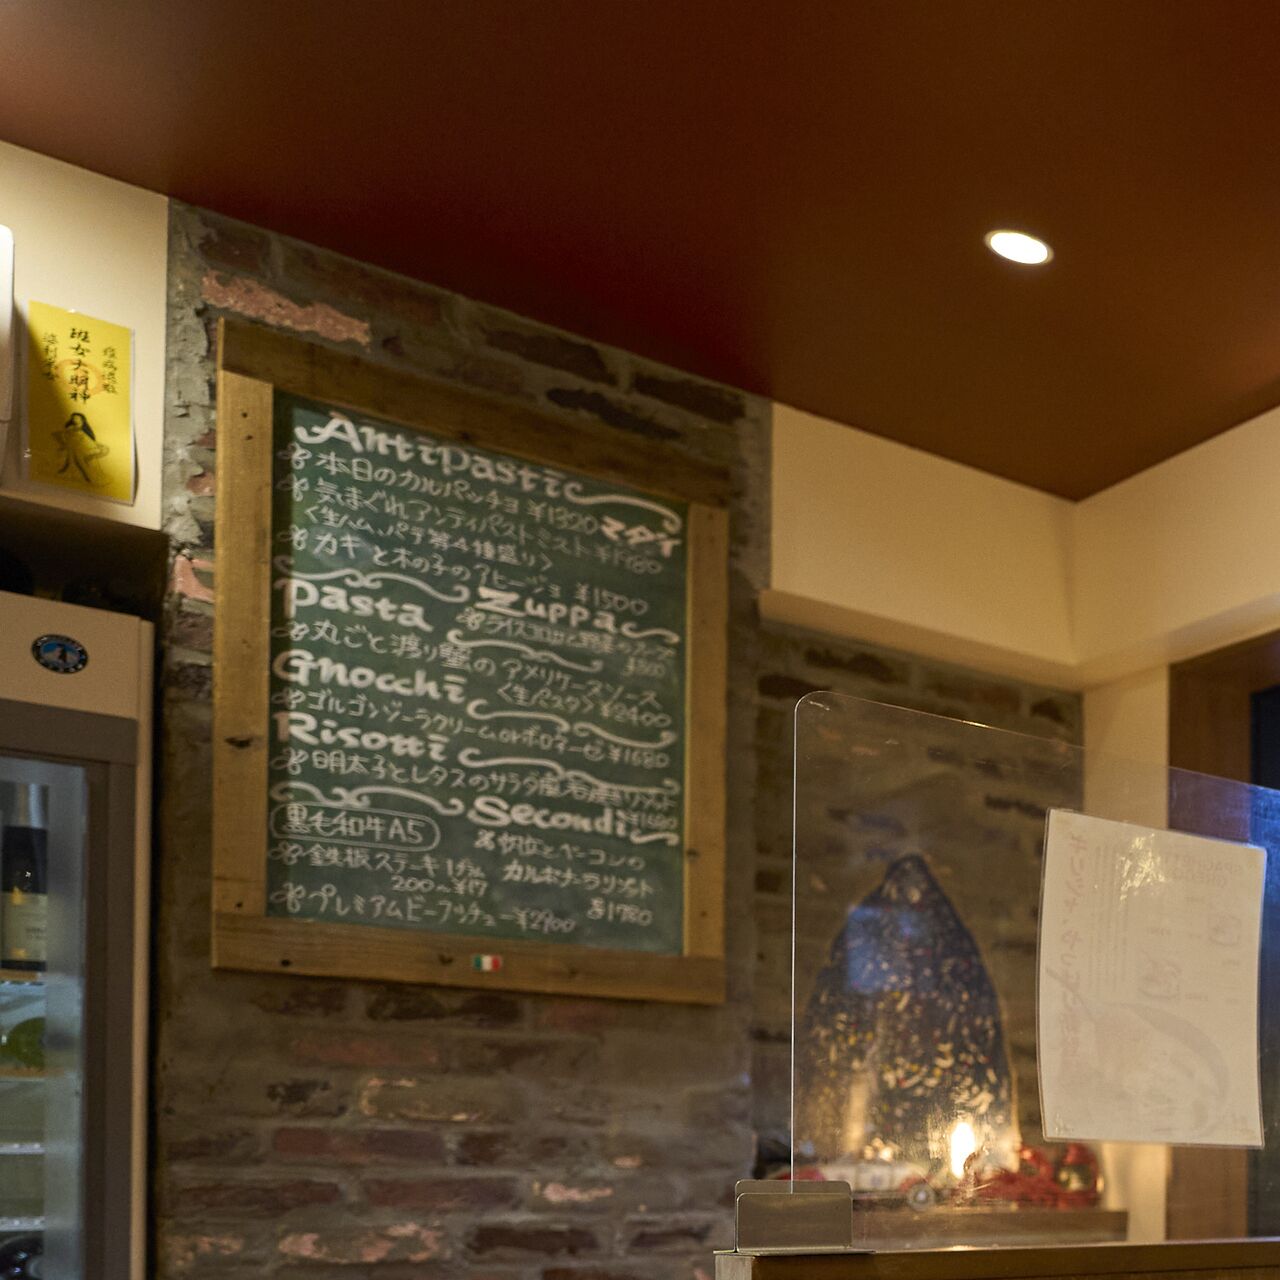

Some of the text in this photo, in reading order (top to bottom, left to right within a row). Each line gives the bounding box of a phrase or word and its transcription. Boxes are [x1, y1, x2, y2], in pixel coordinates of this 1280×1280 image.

[273, 577, 434, 632] Pasta
[474, 586, 618, 633] Zuppa
[272, 649, 467, 704] Gnocchi
[273, 711, 450, 763] Risotti
[467, 796, 627, 838] Secondi
